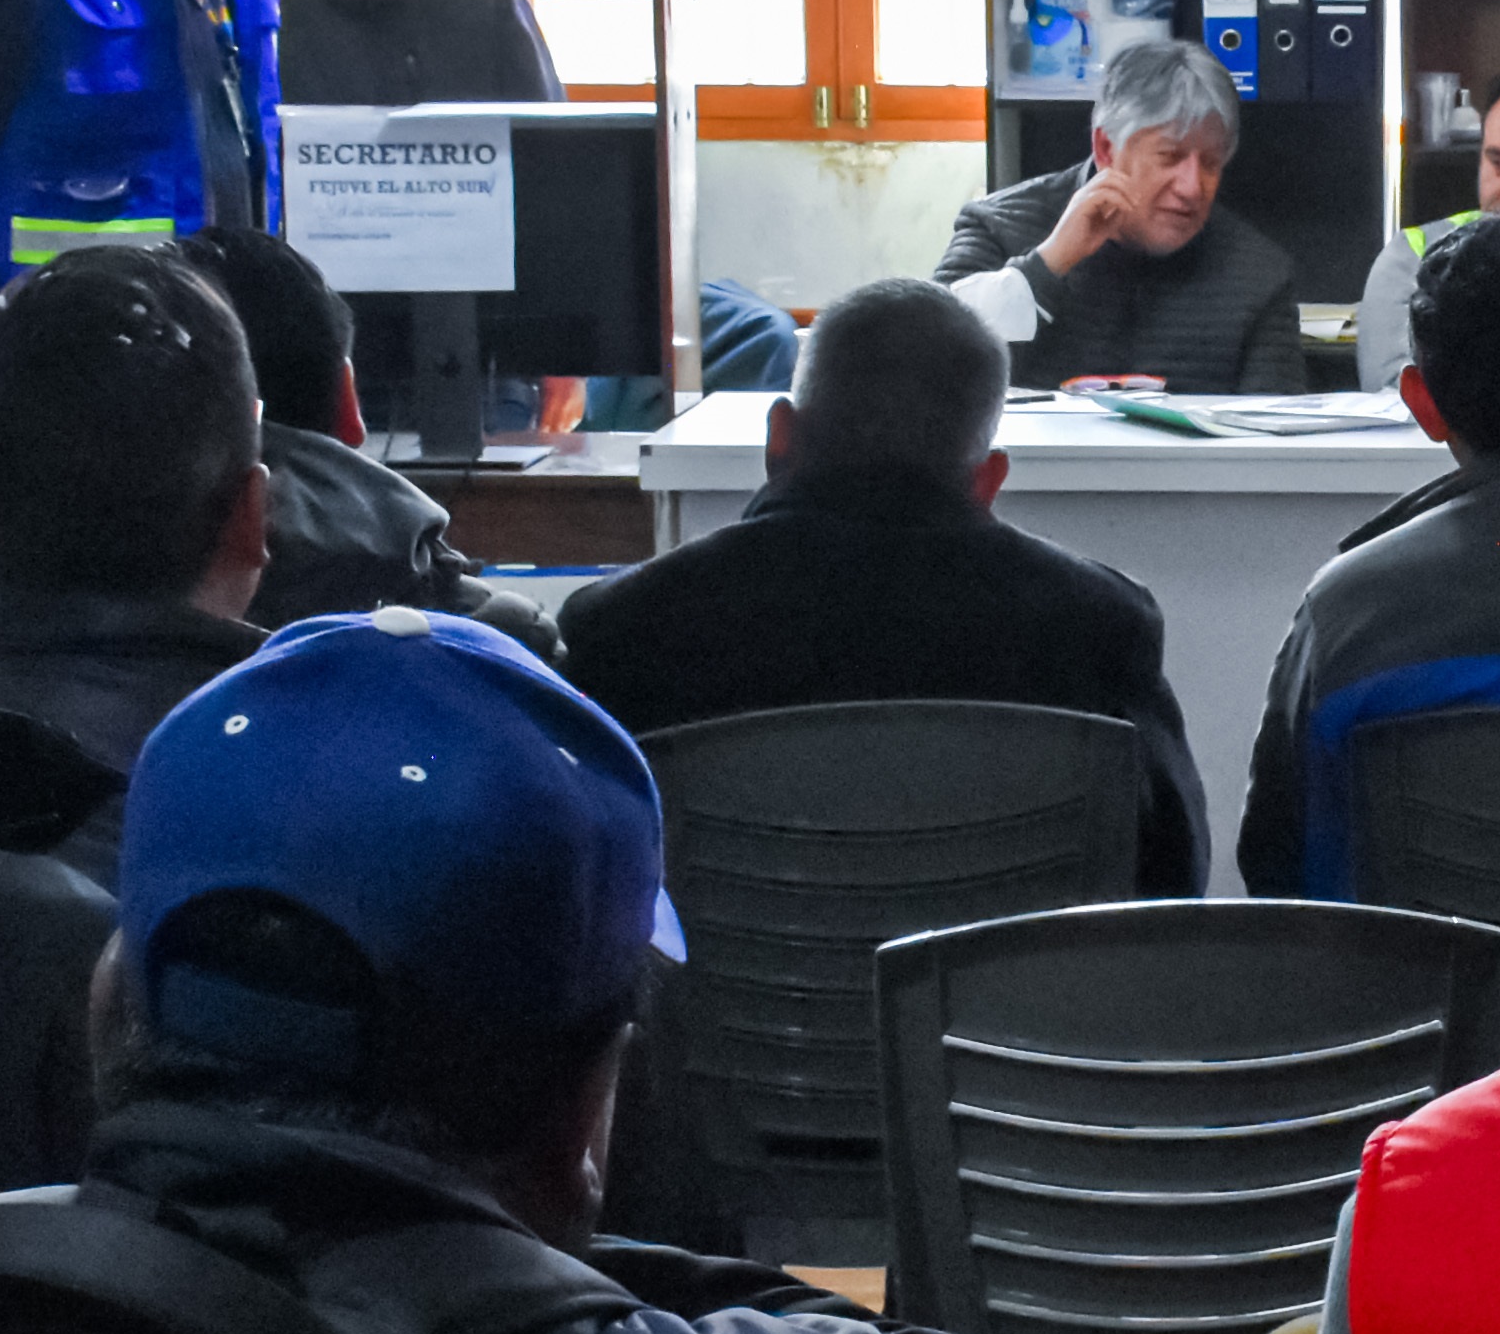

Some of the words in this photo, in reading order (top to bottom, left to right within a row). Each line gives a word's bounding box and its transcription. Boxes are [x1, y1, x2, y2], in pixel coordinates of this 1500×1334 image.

[298, 142, 498, 166] SECRETARIO
[309, 179, 373, 196] FEJUVE
[376, 179, 400, 194] EL
[403, 179, 452, 194] ALTO
[456, 179, 492, 194] SUR
